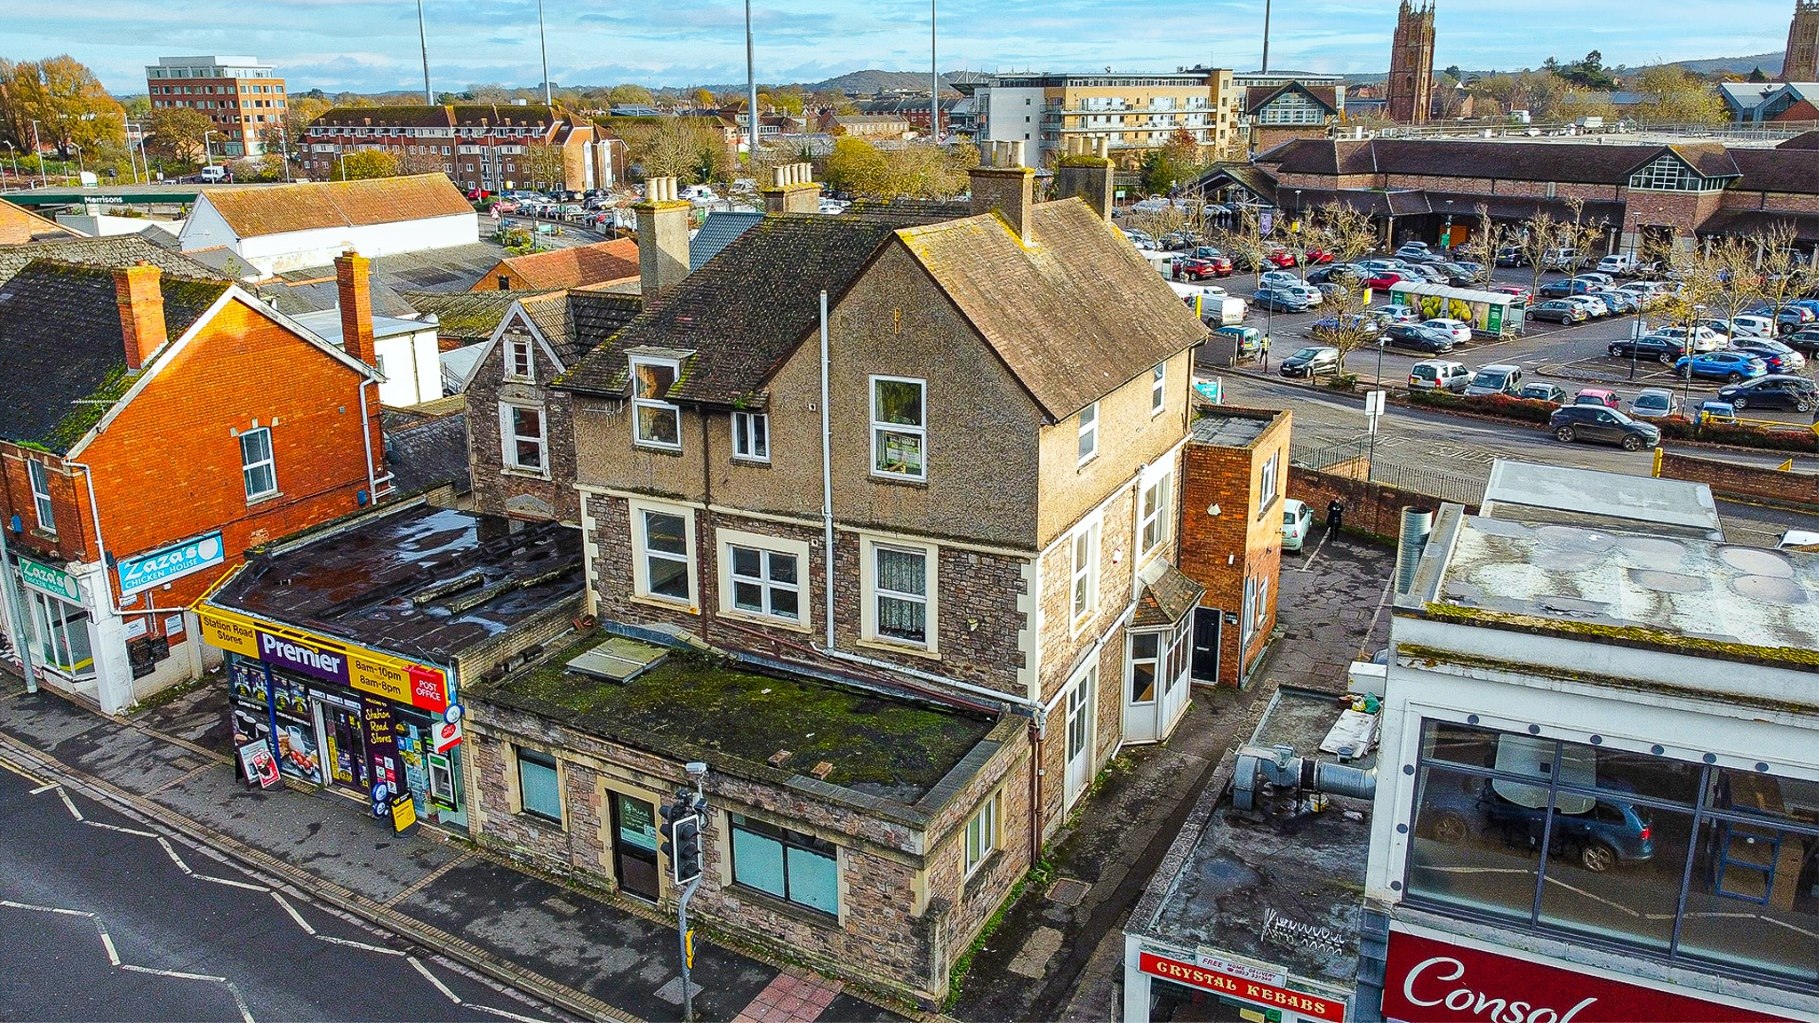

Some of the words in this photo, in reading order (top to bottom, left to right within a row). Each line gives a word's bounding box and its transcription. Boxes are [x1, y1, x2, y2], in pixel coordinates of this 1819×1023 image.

[84, 195, 123, 204] Morrisons
[22, 559, 64, 588] Zaza's
[124, 547, 197, 581] Zaza's
[126, 570, 165, 589] CHICKEN
[170, 558, 197, 574] HOUSE
[203, 616, 232, 632] Station
[232, 623, 254, 639] Road
[216, 629, 243, 646] Stores
[262, 632, 341, 674] Premier
[355, 659, 402, 682] 8am-10pm
[360, 674, 402, 695] 8am-8pm
[415, 687, 442, 702] OFFICE
[418, 679, 438, 692] POST
[365, 708, 391, 721] Station
[370, 721, 390, 732] Road
[370, 732, 393, 744] Stores
[1202, 957, 1223, 968] FREE
[1227, 963, 1246, 971] HOME
[1248, 968, 1277, 979] DELIVERY
[1246, 984, 1326, 1015] KEBABS
